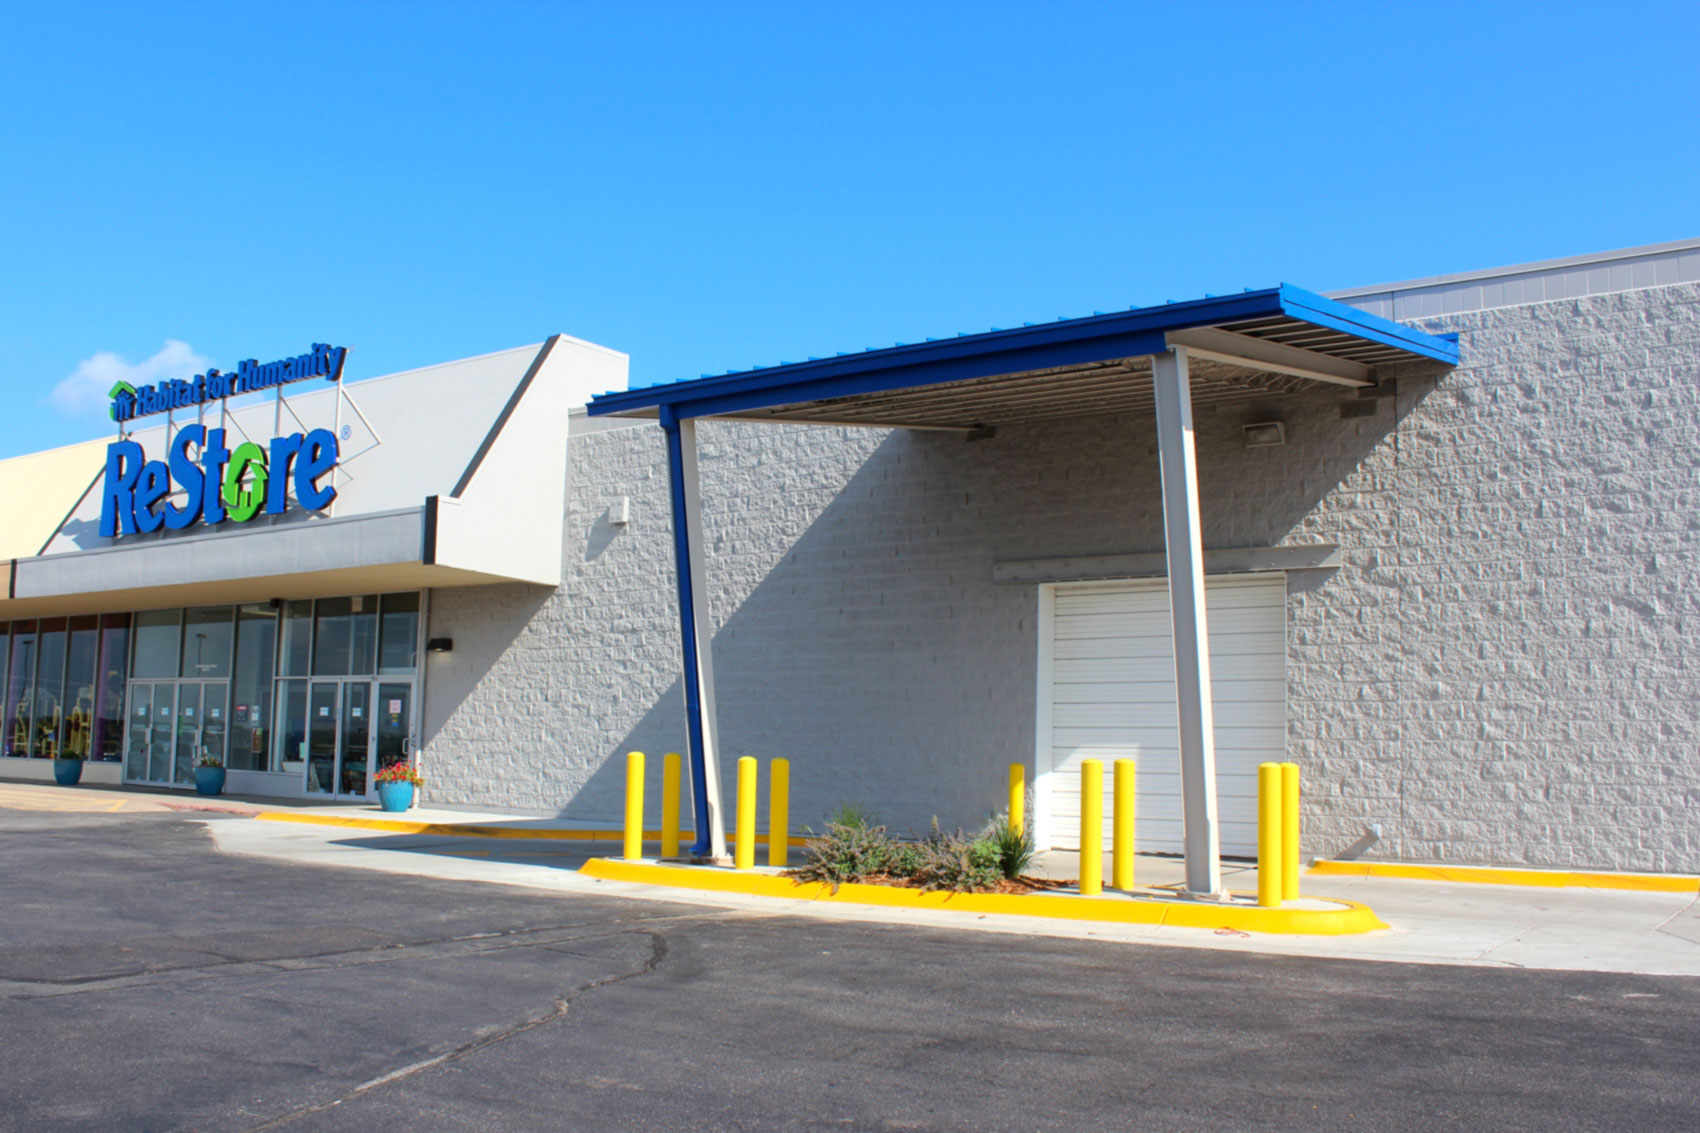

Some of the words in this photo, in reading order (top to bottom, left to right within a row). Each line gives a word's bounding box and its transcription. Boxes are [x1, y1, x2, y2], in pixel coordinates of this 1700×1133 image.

[136, 376, 205, 416] Habitat
[204, 369, 237, 399] for
[238, 343, 346, 392] Humanity
[100, 424, 339, 537] ReStore
